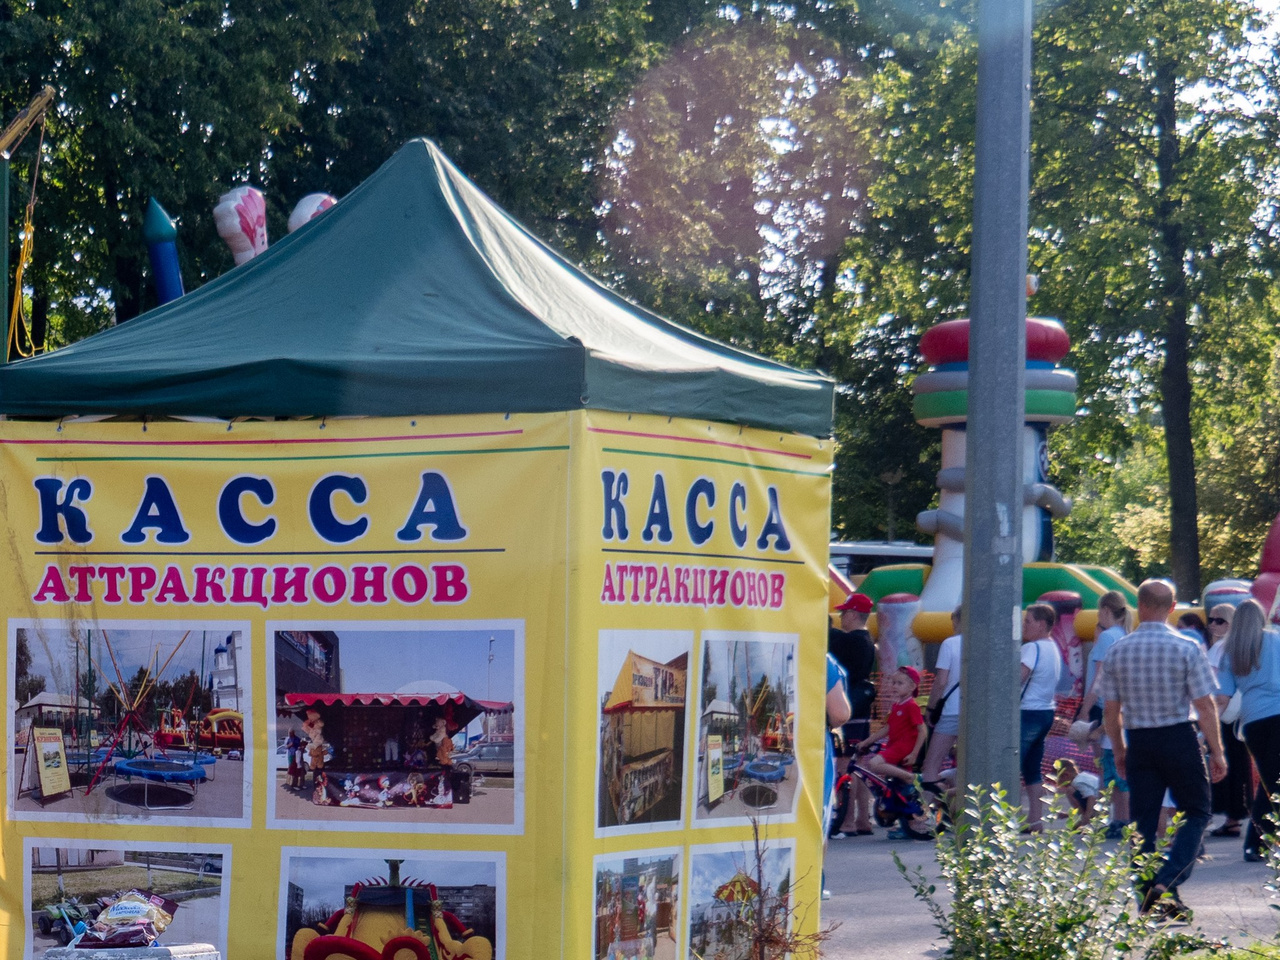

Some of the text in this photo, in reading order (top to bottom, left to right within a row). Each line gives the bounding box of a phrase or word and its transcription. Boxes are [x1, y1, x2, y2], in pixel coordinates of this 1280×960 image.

[34, 472, 467, 544] КАССА
[600, 470, 791, 551] КАССА
[33, 565, 468, 609] АТТРАКЦИОНОВ
[601, 563, 785, 609] АТТРАКЦИОНОВ
